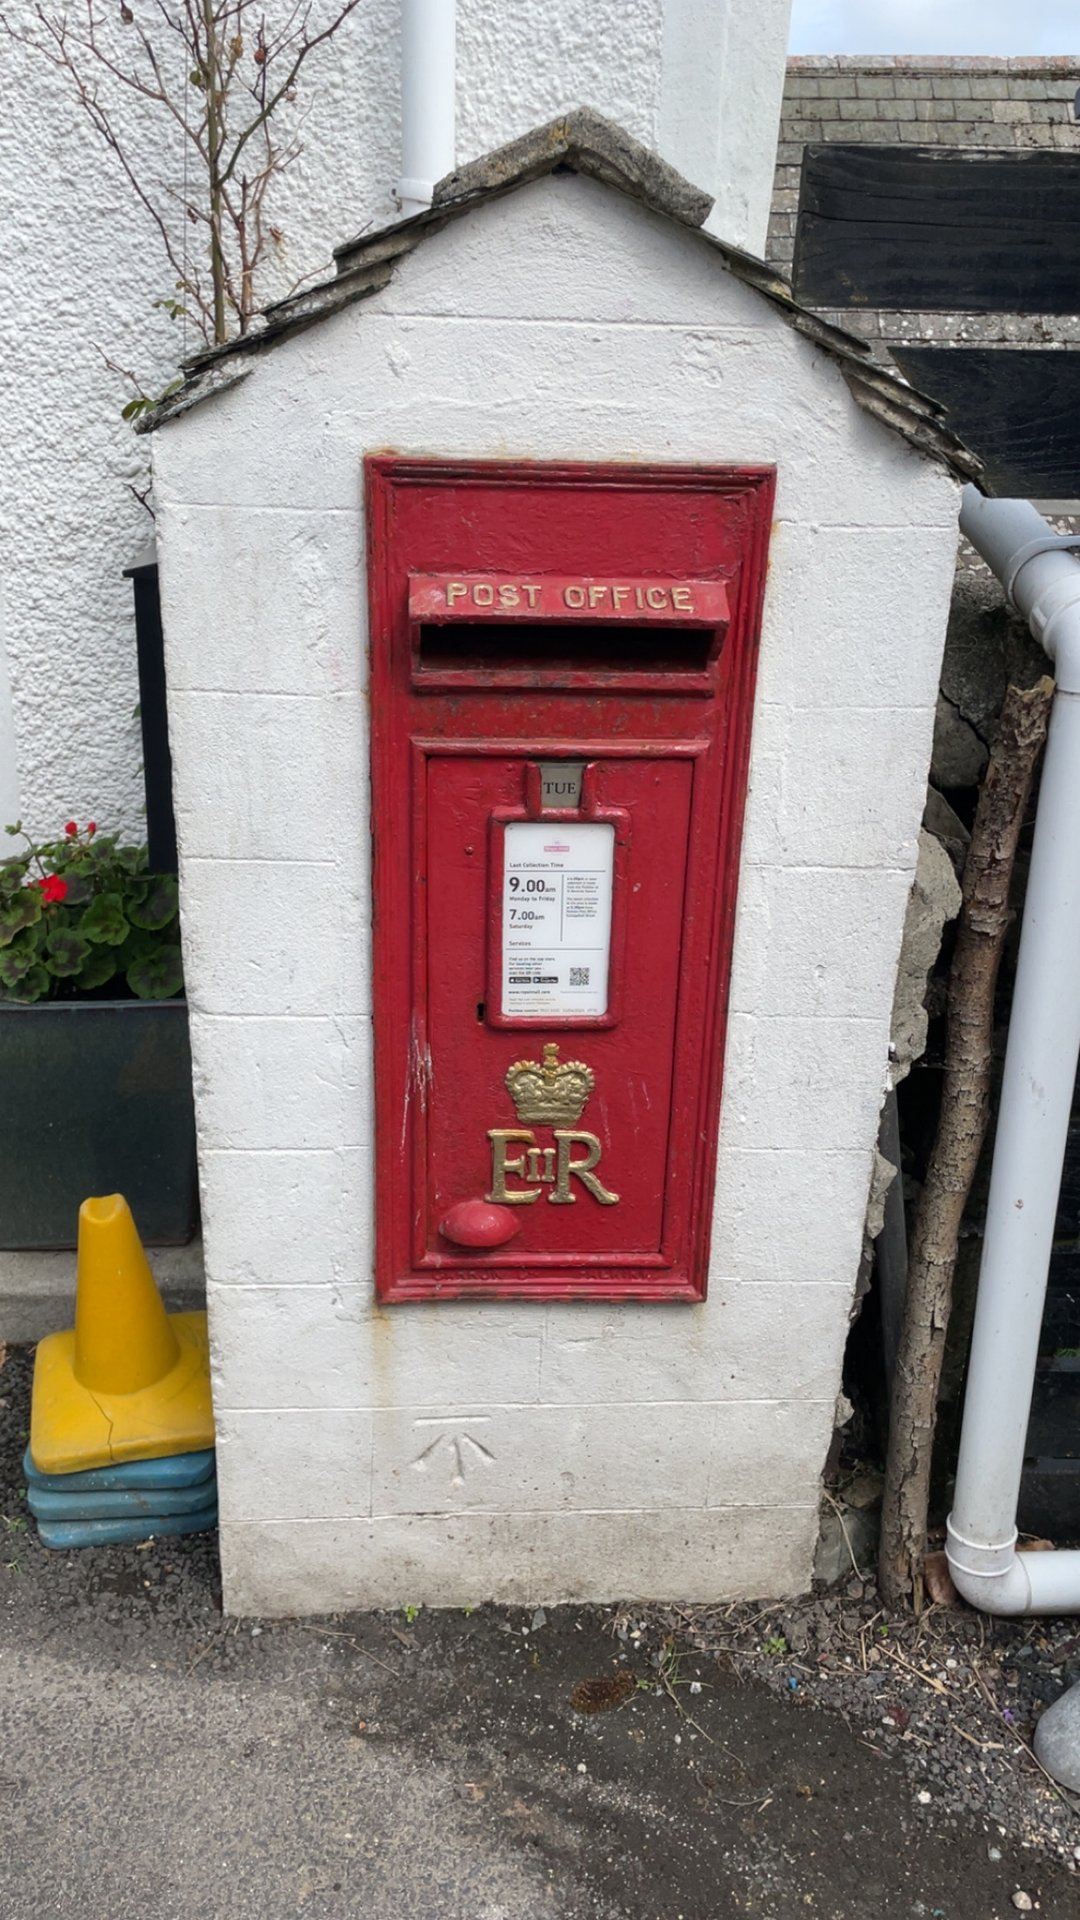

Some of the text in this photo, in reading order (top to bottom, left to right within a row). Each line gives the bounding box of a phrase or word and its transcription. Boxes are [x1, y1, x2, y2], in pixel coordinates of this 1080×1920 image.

[446, 582, 695, 612] POST OFFICE
[543, 782, 577, 795] TUE
[509, 876, 556, 893] 9.00am
[509, 908, 545, 920] 7.00am
